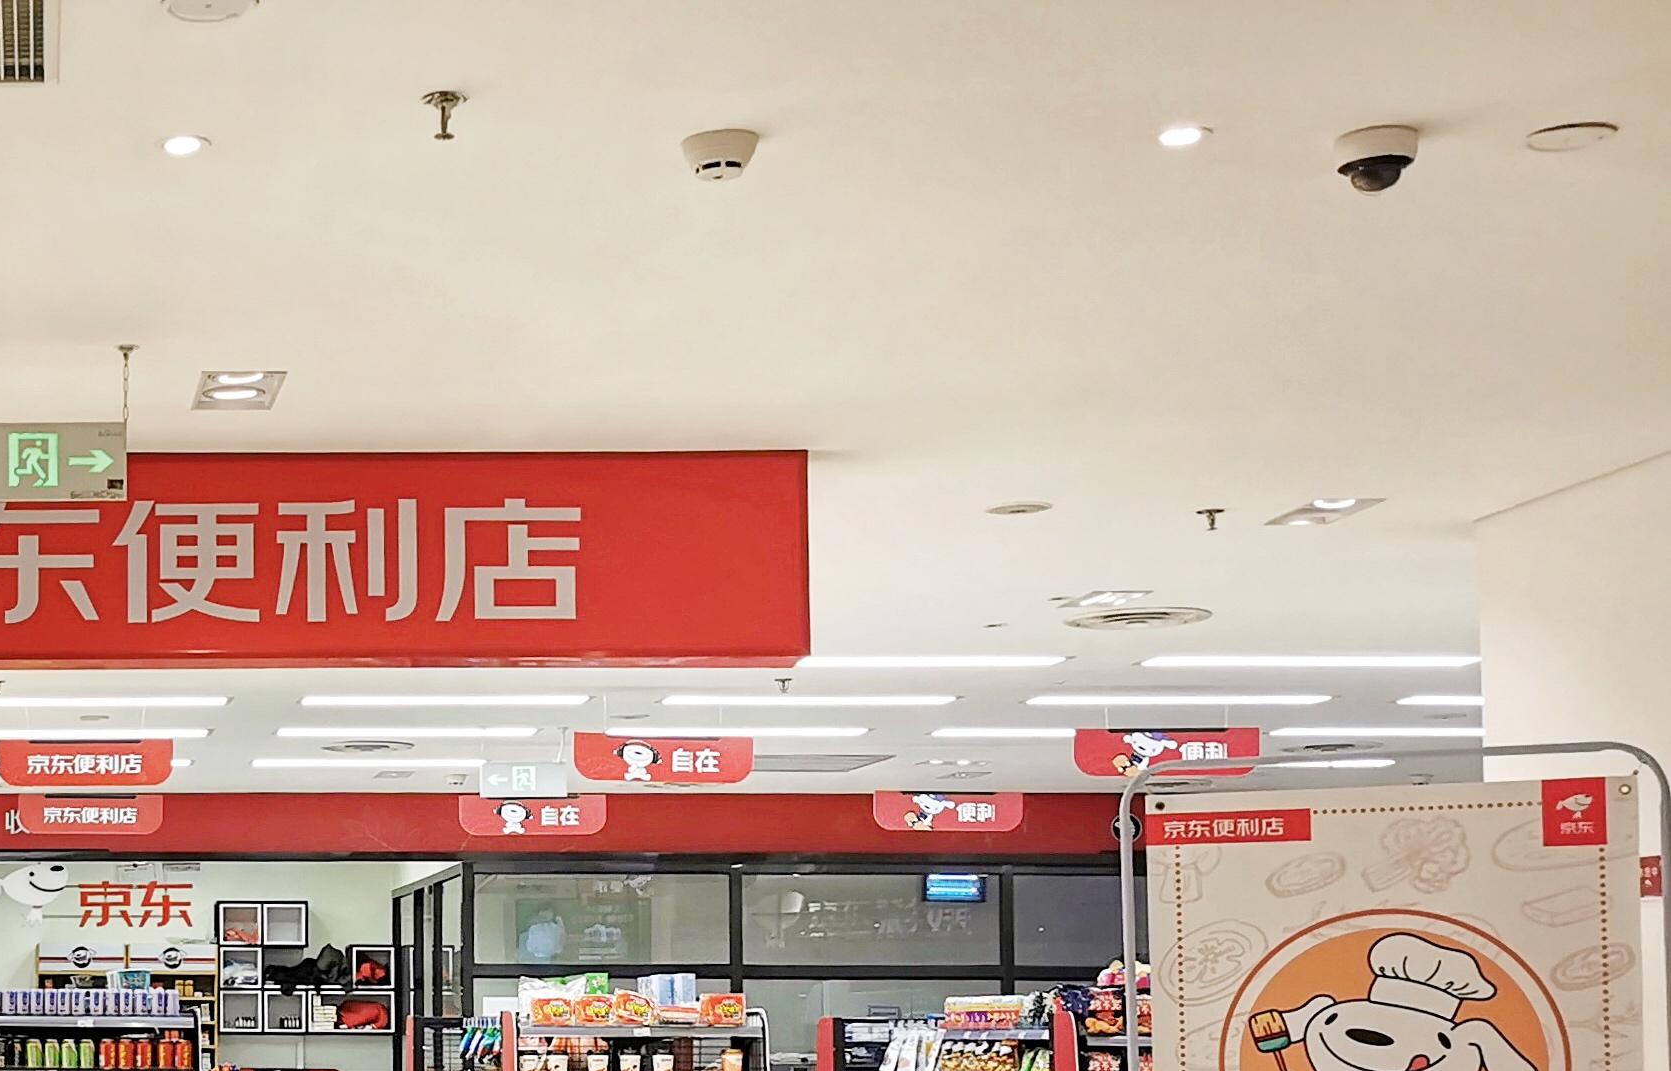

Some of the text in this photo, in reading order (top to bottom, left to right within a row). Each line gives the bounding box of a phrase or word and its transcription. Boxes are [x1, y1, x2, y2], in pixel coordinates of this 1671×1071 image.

[672, 748, 720, 773] 自在
[1179, 742, 1228, 760] 便利
[28, 754, 142, 774] 京东便利店
[44, 807, 137, 824] 京东便利店
[541, 805, 580, 825] 自在
[956, 803, 995, 822] 便利
[1164, 817, 1283, 838] 京东便利店
[1561, 822, 1594, 834] 京东
[80, 881, 191, 927] 京东
